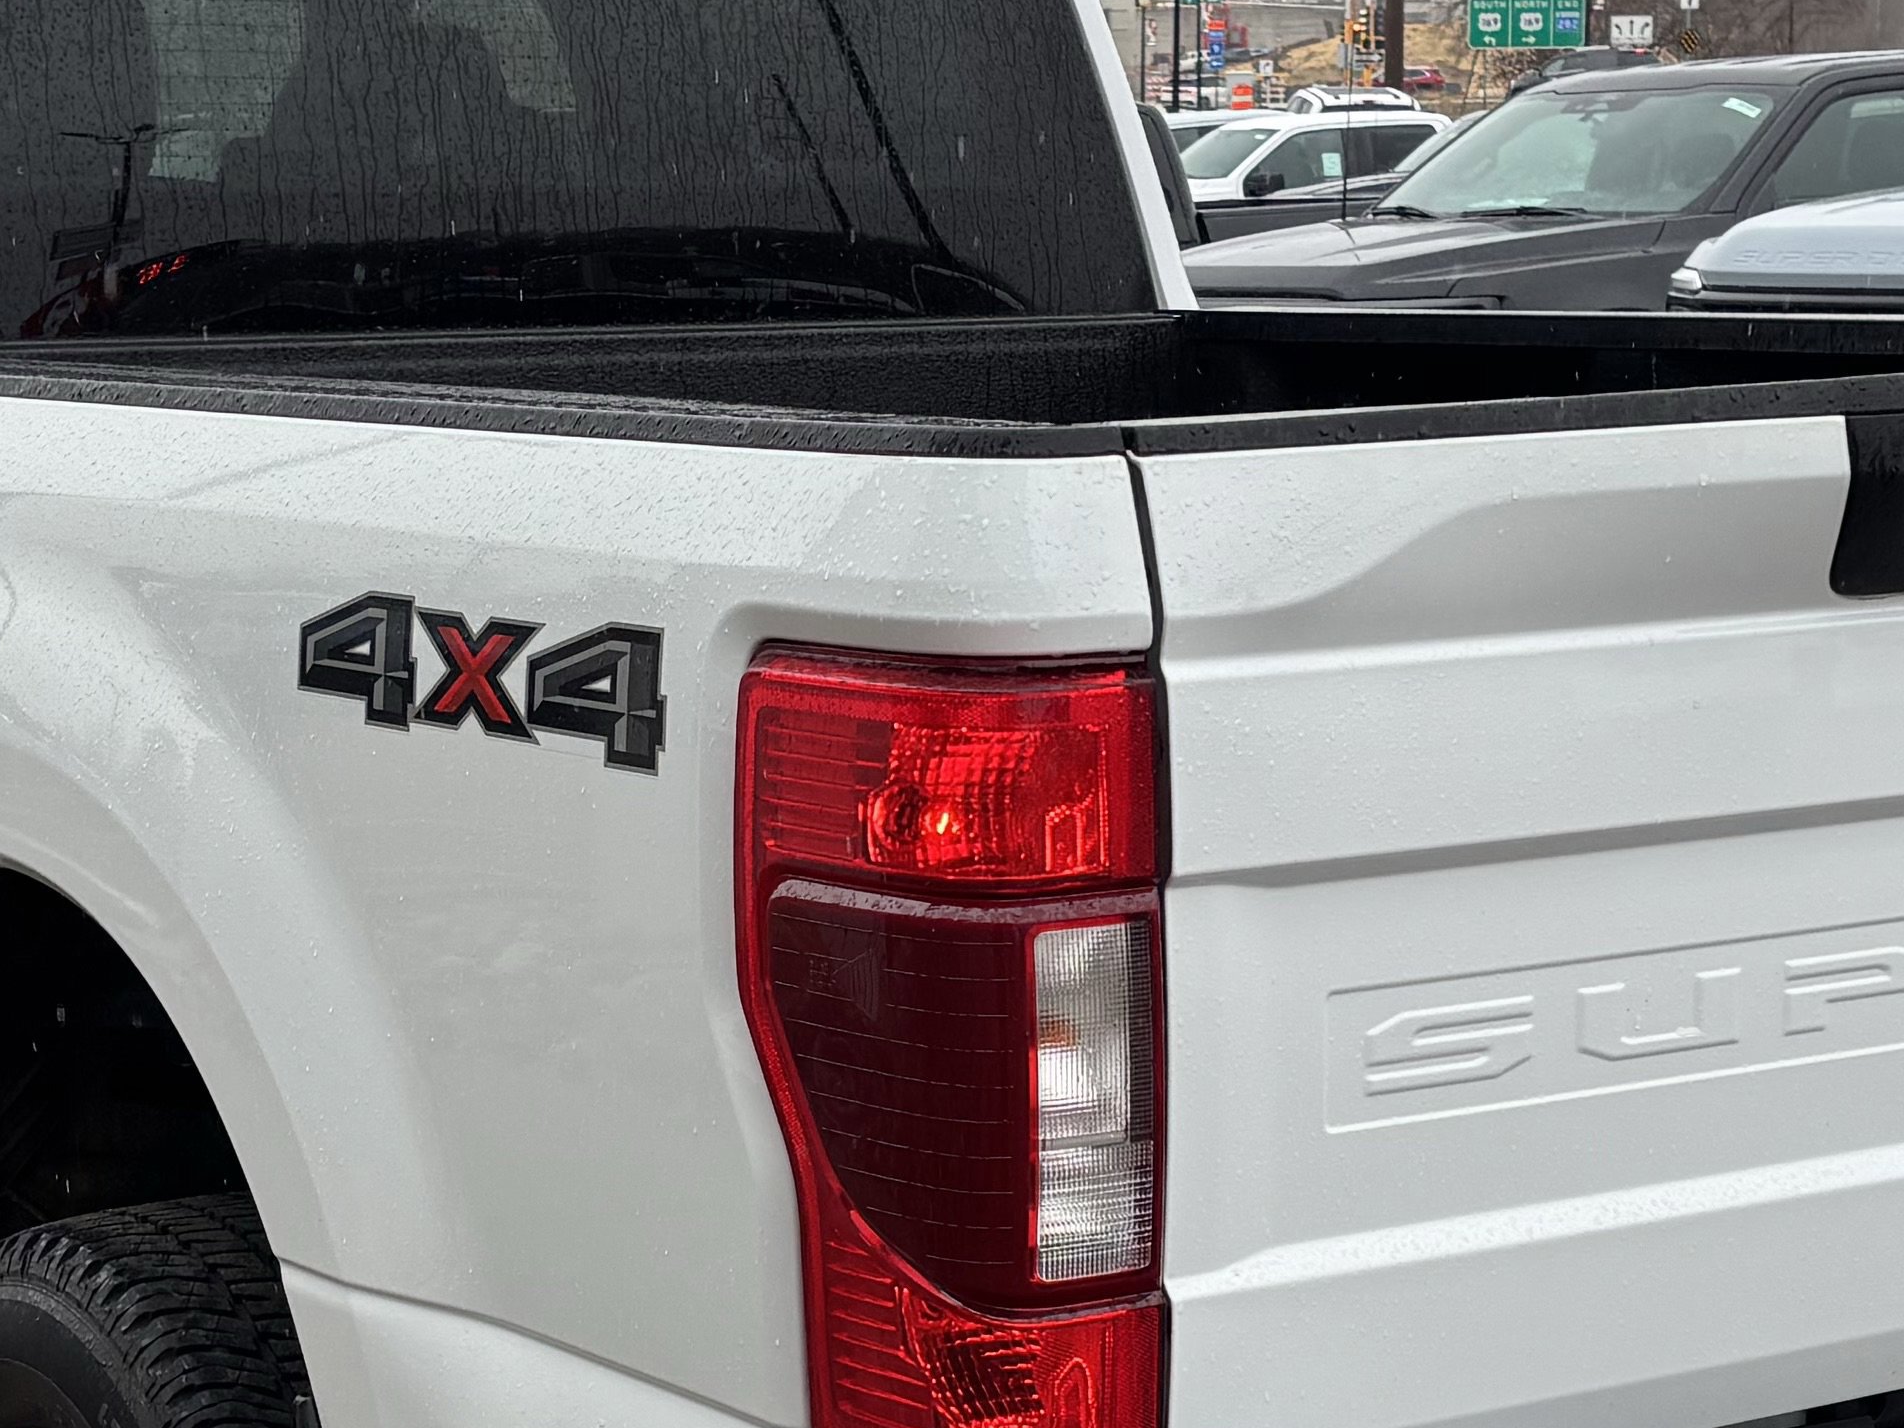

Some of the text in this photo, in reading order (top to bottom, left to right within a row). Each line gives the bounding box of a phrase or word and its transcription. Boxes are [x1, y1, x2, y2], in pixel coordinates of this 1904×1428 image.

[1473, 0, 1507, 10] SOUTH
[1514, 0, 1549, 10] NORTH
[1557, 0, 1580, 10] END
[1732, 249, 1860, 266] SUPER
